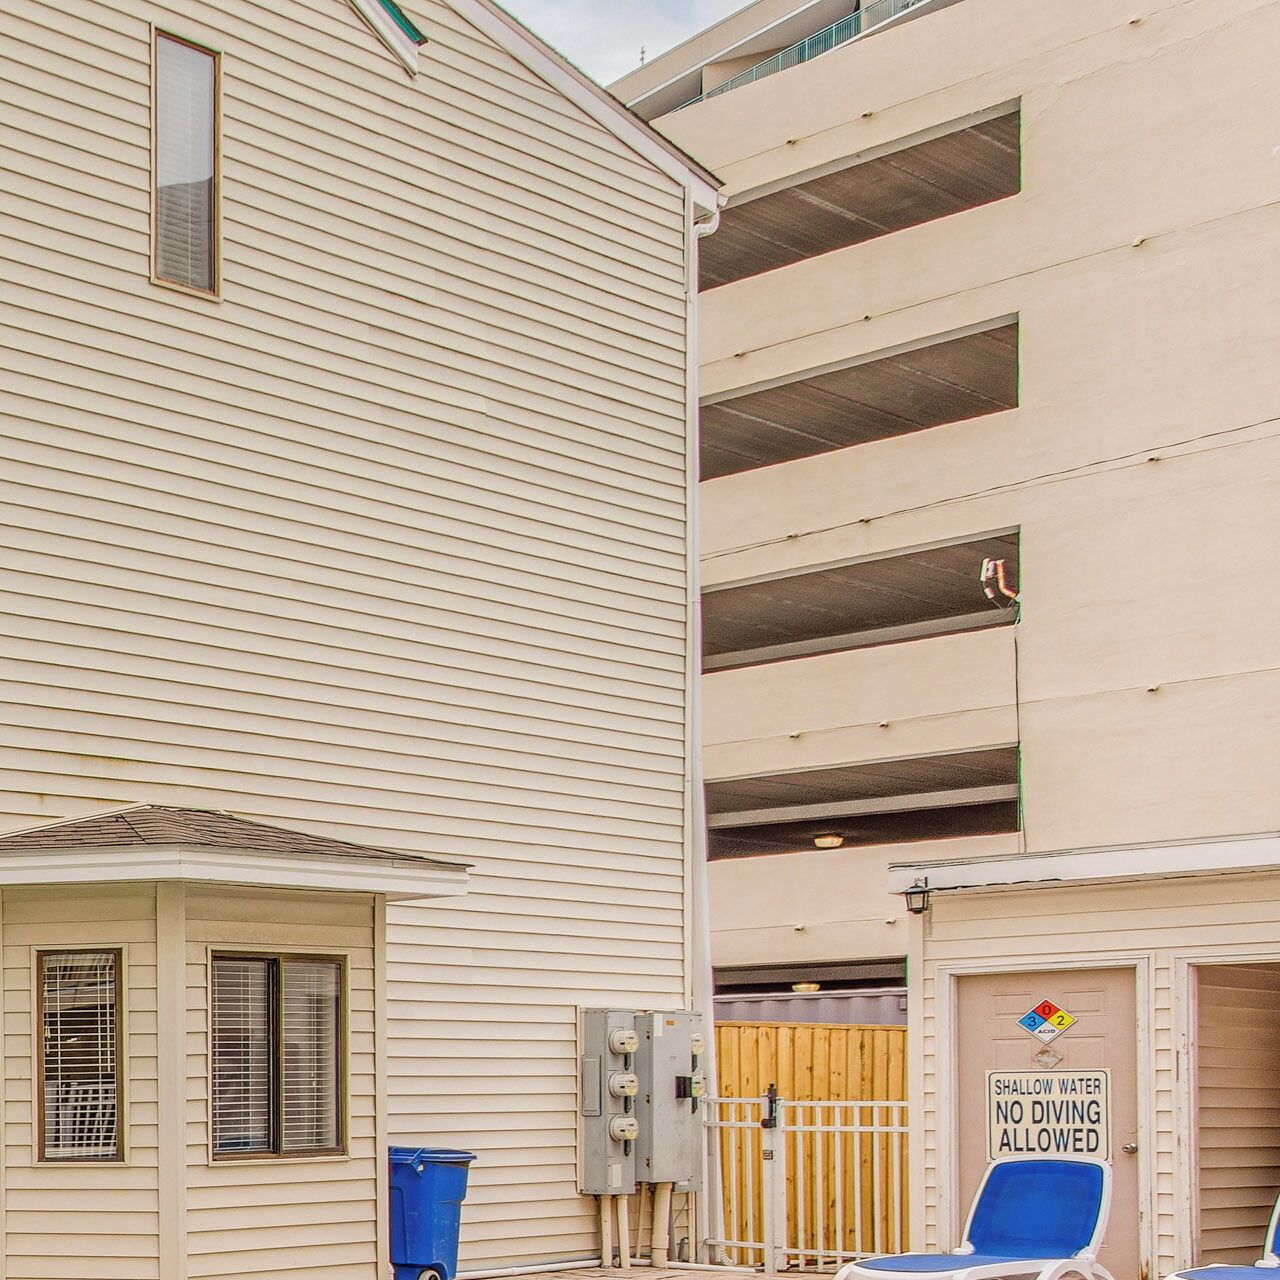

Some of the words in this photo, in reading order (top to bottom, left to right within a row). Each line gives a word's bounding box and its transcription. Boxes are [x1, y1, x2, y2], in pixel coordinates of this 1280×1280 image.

[1042, 1005, 1052, 1015] 0
[1028, 1016, 1037, 1027] 3
[1056, 1015, 1065, 1026] 2
[995, 1079, 1053, 1095] SHALLOW
[1058, 1078, 1101, 1095] WATER
[996, 1100, 1023, 1124] NO
[1032, 1100, 1101, 1124] DIVING
[999, 1128, 1099, 1153] ALLOWED
